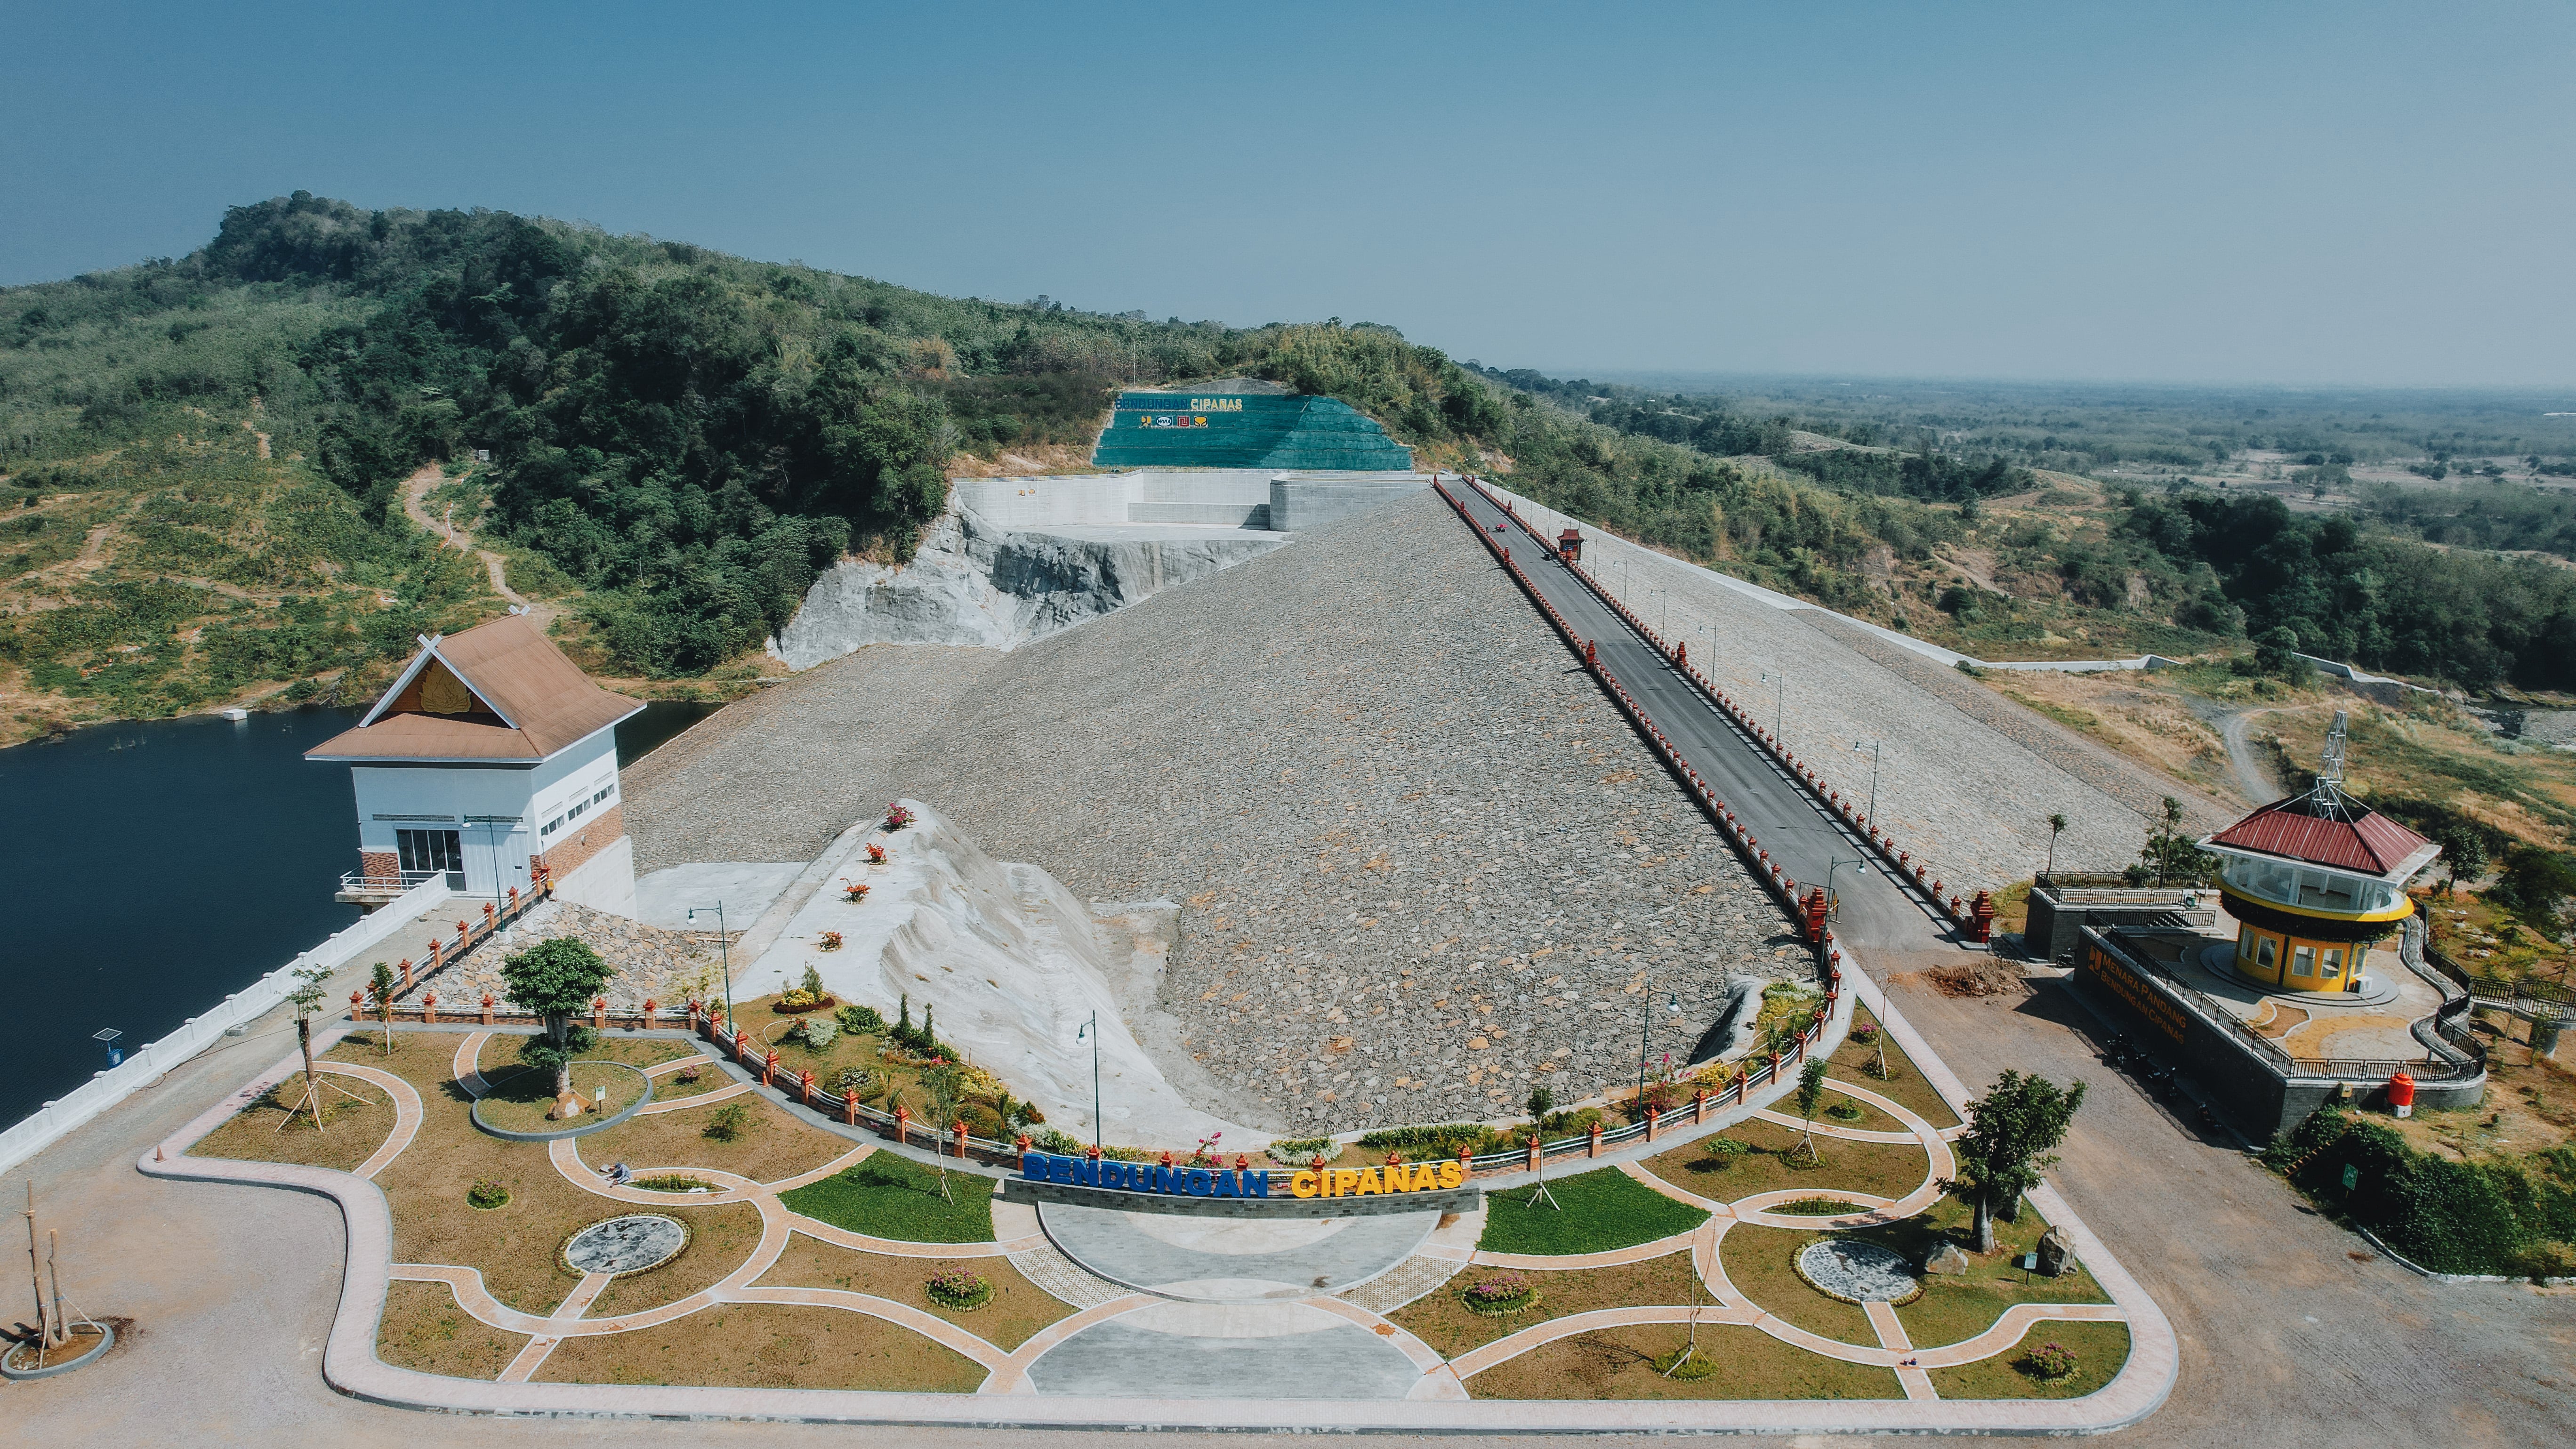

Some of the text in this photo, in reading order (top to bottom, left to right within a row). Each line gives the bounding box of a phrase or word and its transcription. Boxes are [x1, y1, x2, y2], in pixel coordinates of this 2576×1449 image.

[1115, 399, 1243, 411] BENDUNGAN CIPANAS
[2101, 970, 2184, 1045] BENDUNGAN CIPANAS
[2103, 954, 2187, 1029] MENARA PANDANG
[1023, 1152, 1463, 1198] BENDUNGAN CIPANAS
